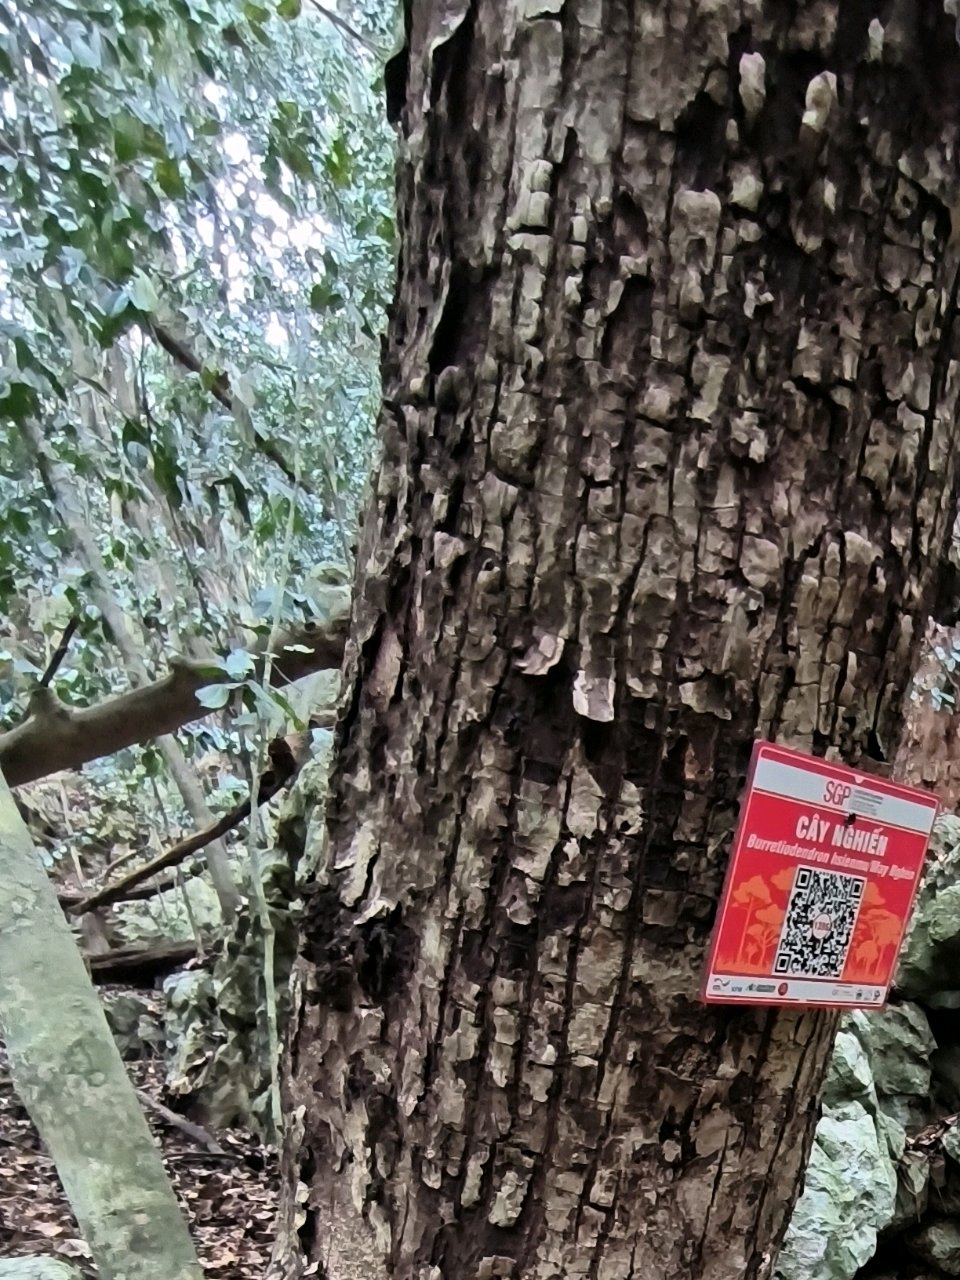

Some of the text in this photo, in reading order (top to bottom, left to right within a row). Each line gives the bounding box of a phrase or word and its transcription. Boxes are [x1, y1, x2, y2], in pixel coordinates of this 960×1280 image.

[823, 780, 851, 807] SGP
[747, 833, 830, 864] Burretiodendron
[795, 813, 889, 857] CÂY NGHIẾN
